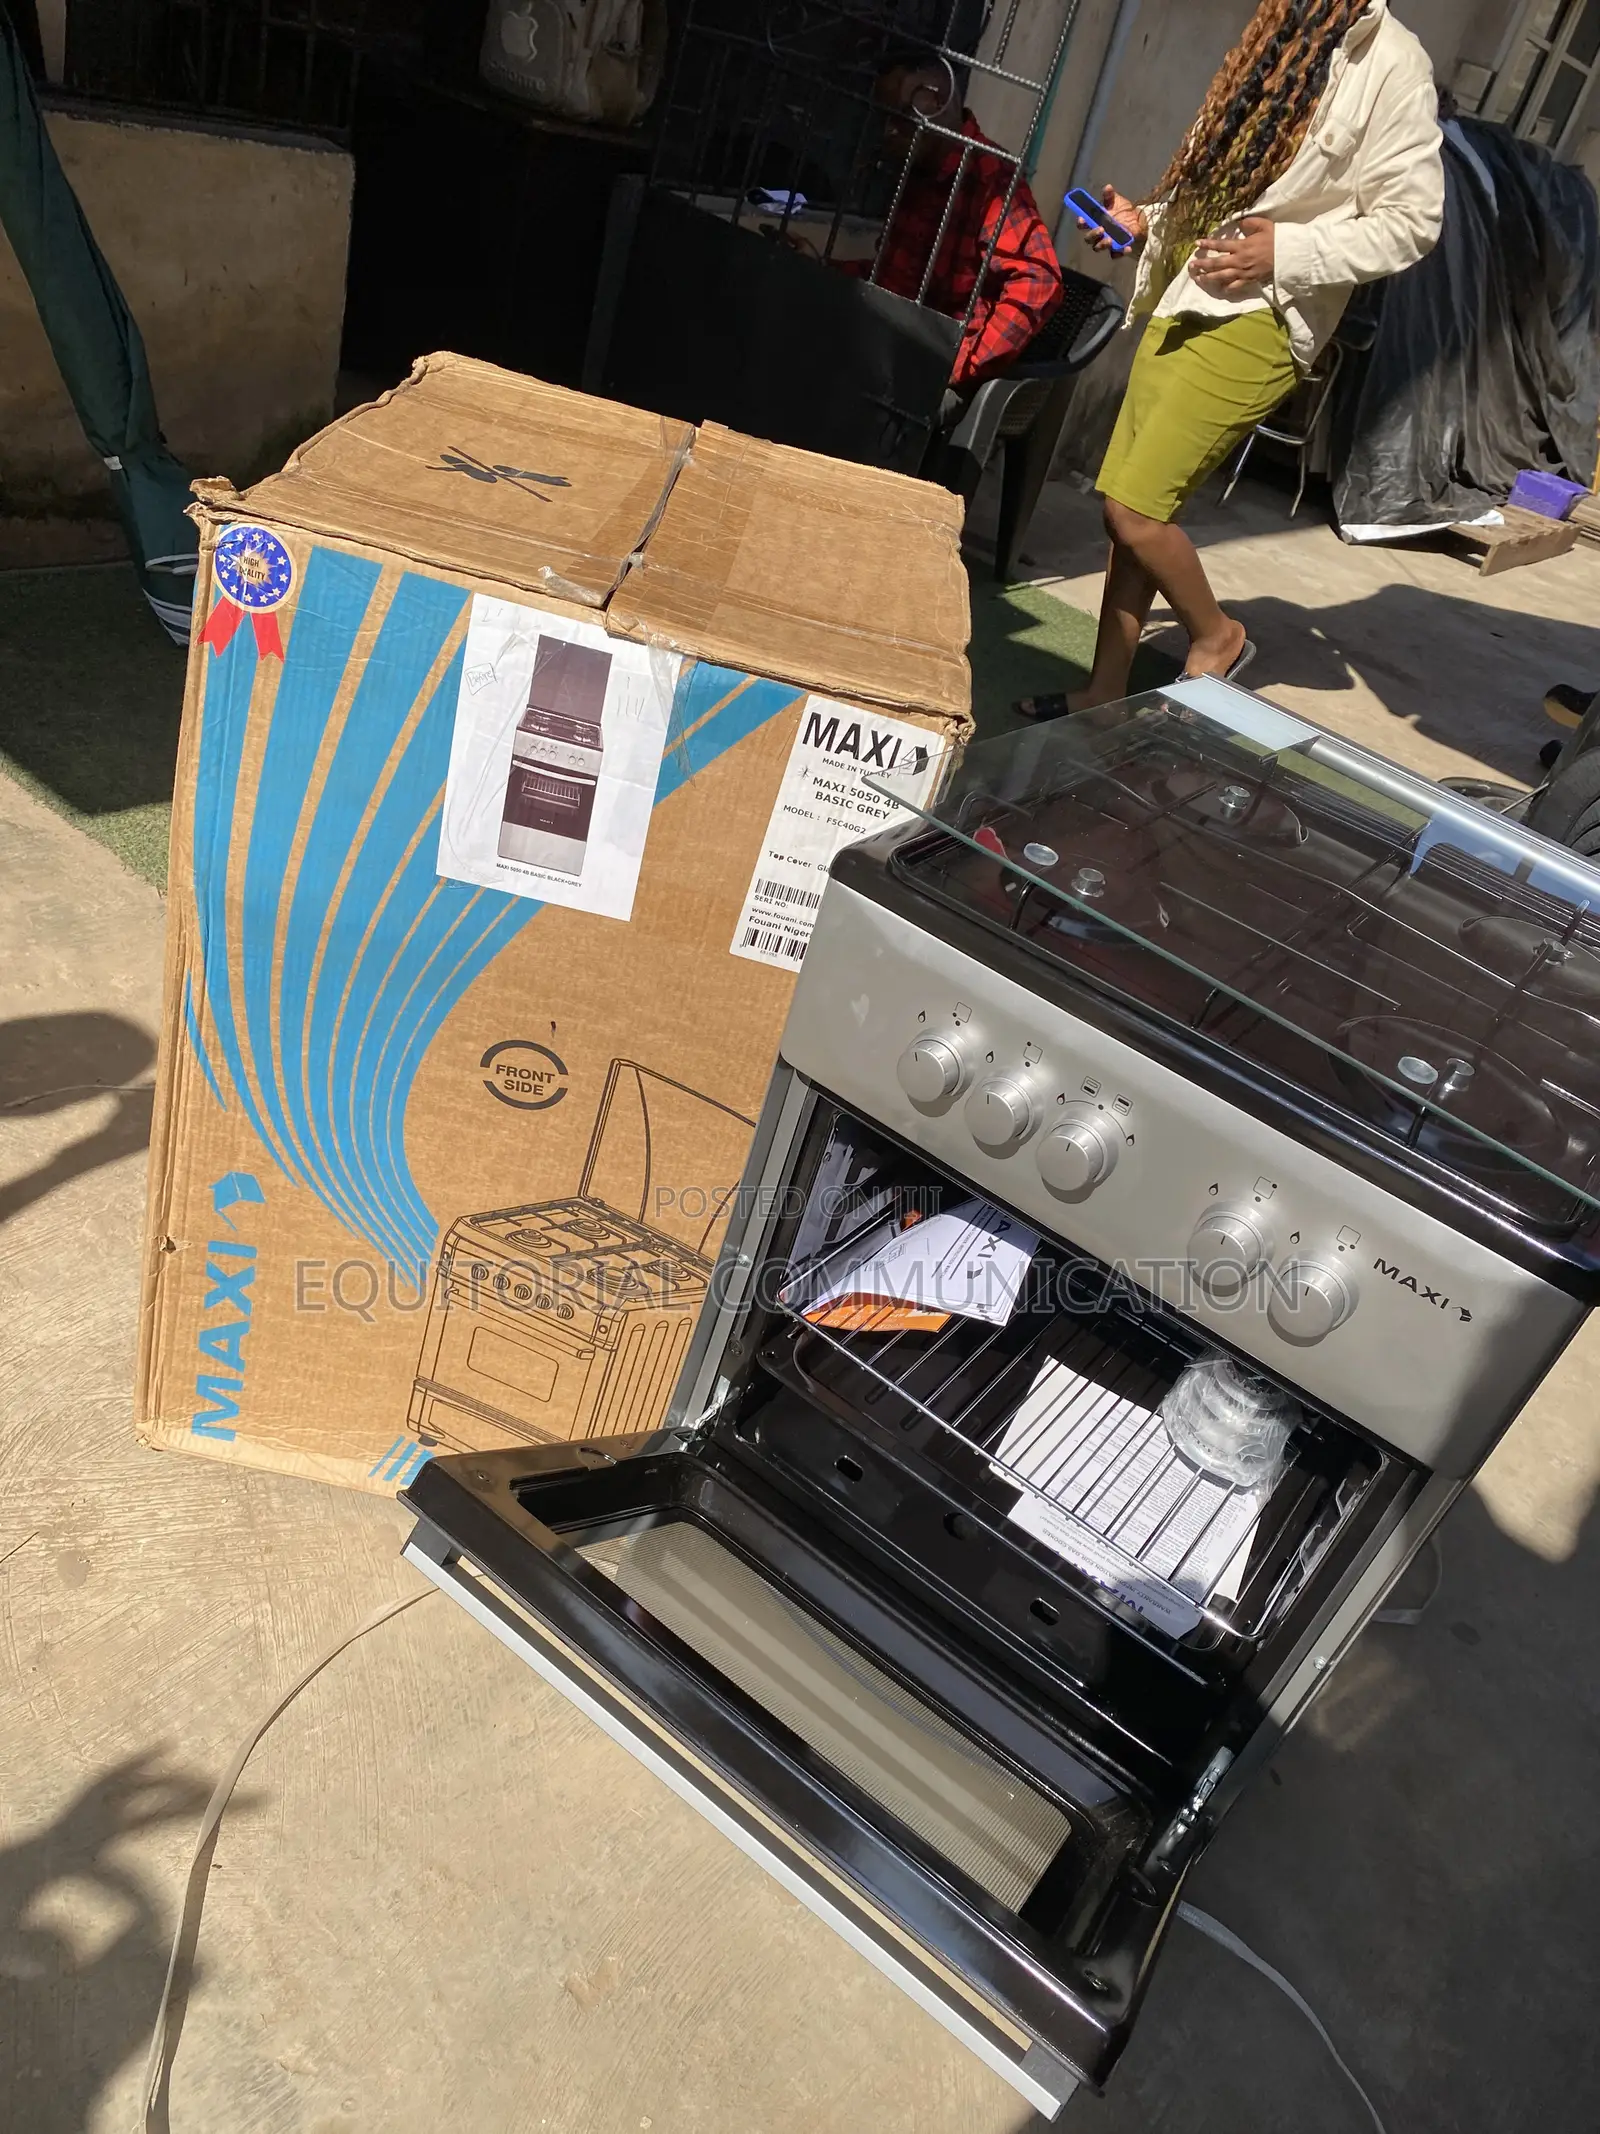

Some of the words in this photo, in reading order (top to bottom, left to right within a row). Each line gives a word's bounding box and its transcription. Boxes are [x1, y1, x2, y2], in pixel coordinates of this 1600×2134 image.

[243, 556, 260, 568] HIGH
[802, 711, 903, 770] MAXI
[822, 757, 845, 770] MADE
[847, 765, 858, 773] IN
[812, 776, 846, 794] MAXI
[849, 787, 881, 804] 5050
[883, 798, 900, 810] 4B
[783, 804, 815, 819] MODEL
[815, 791, 854, 809] BASIC
[857, 803, 891, 820] GREY
[768, 850, 785, 861] Top
[786, 855, 813, 868] Cover
[530, 871, 546, 880] BASIC
[748, 915, 782, 930] Fouani
[496, 1064, 556, 1084] FRONT
[503, 1079, 545, 1096] SIDE
[977, 1215, 1012, 1258] AXI
[1373, 1257, 1450, 1310] MAXI
[191, 1240, 258, 1443] MAXI
